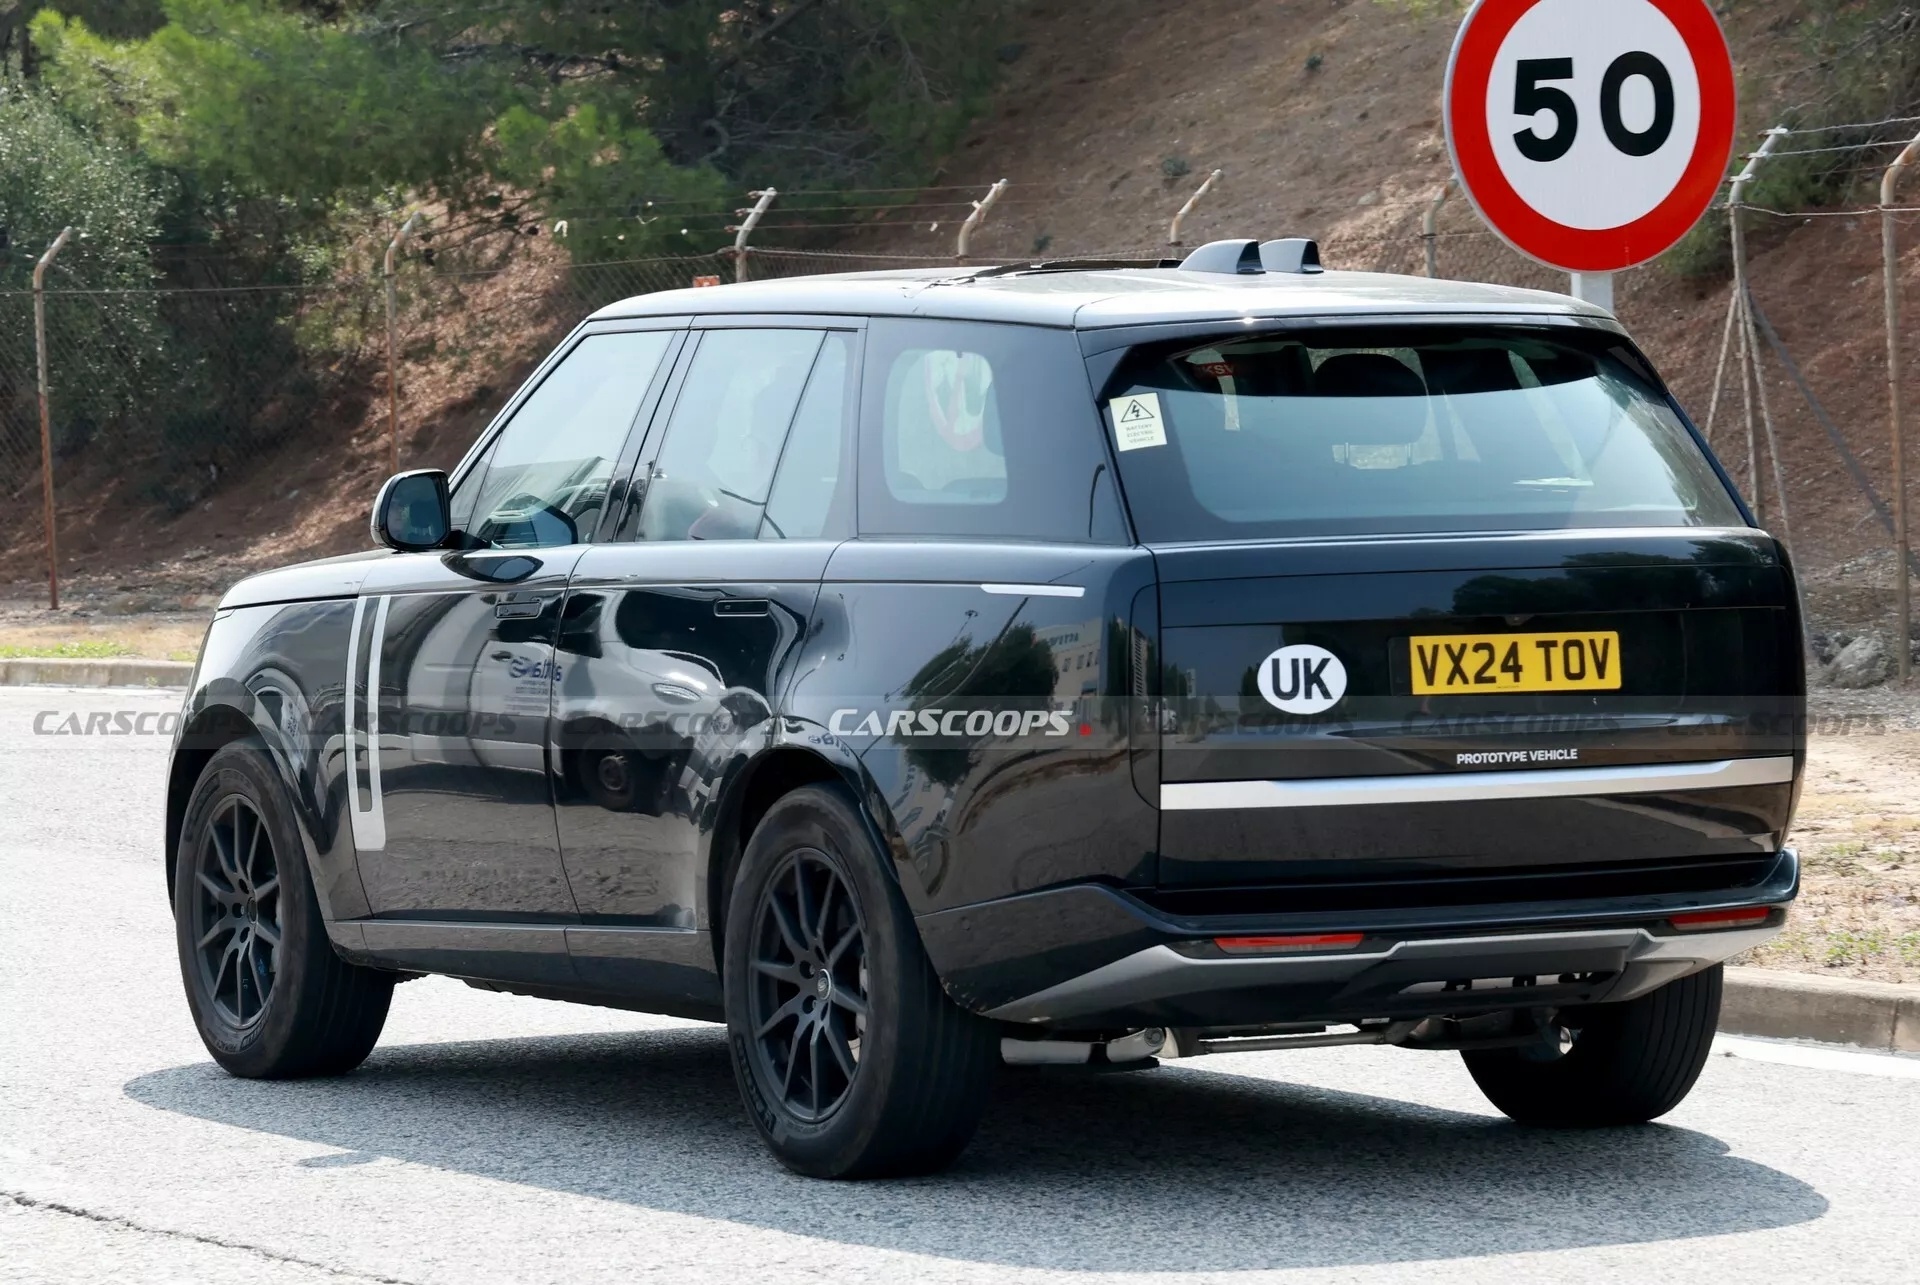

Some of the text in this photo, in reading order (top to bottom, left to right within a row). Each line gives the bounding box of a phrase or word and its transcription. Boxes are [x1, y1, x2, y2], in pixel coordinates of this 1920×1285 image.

[1513, 51, 1675, 162] 50
[1271, 657, 1333, 701] UK
[1417, 638, 1610, 686] VX24 TOV
[1456, 749, 1578, 765] PROTOTYPE VEHICLE
